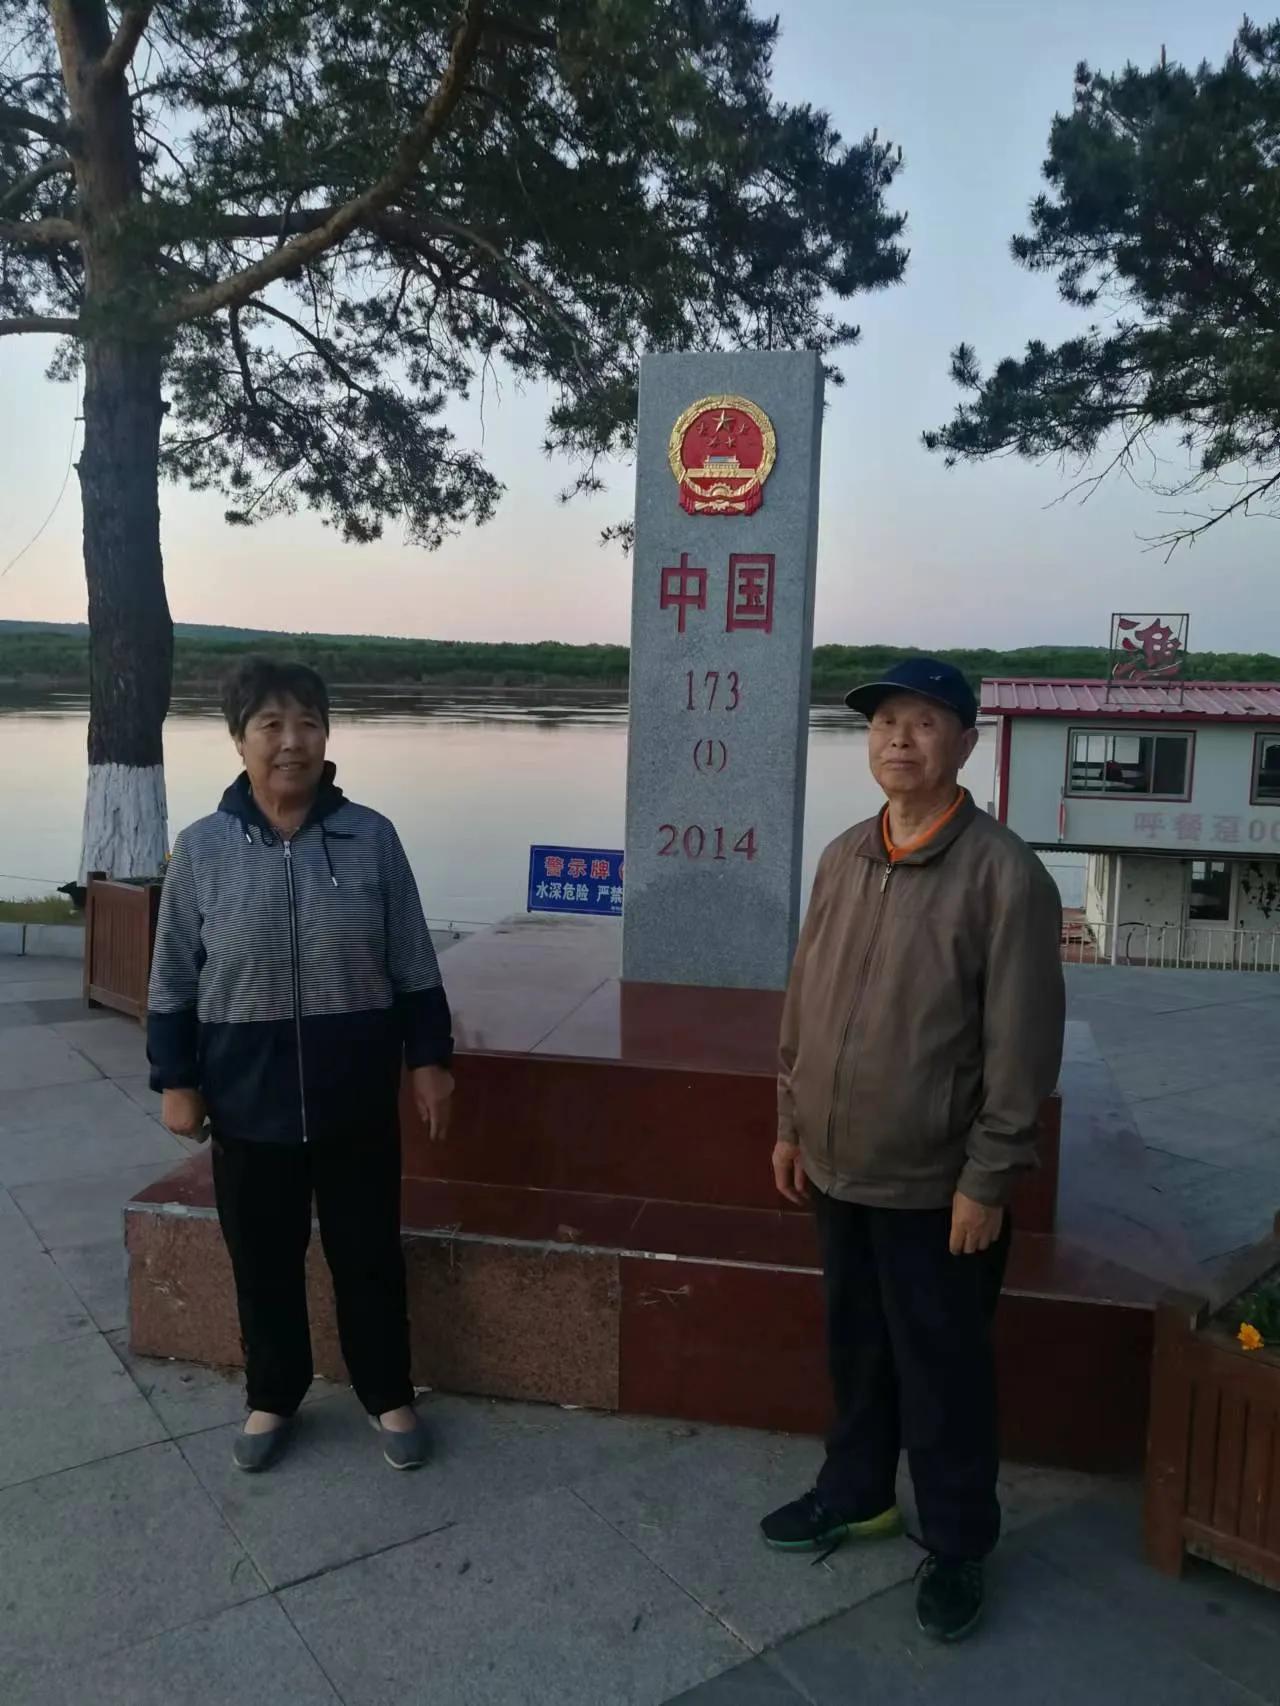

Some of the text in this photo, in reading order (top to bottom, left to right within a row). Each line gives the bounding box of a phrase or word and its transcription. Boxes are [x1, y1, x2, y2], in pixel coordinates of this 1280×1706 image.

[660, 552, 775, 634] 中国
[686, 670, 741, 712] 173
[657, 823, 758, 862] 2014
[544, 856, 611, 880] 警示牌
[536, 881, 590, 902] 水深危险
